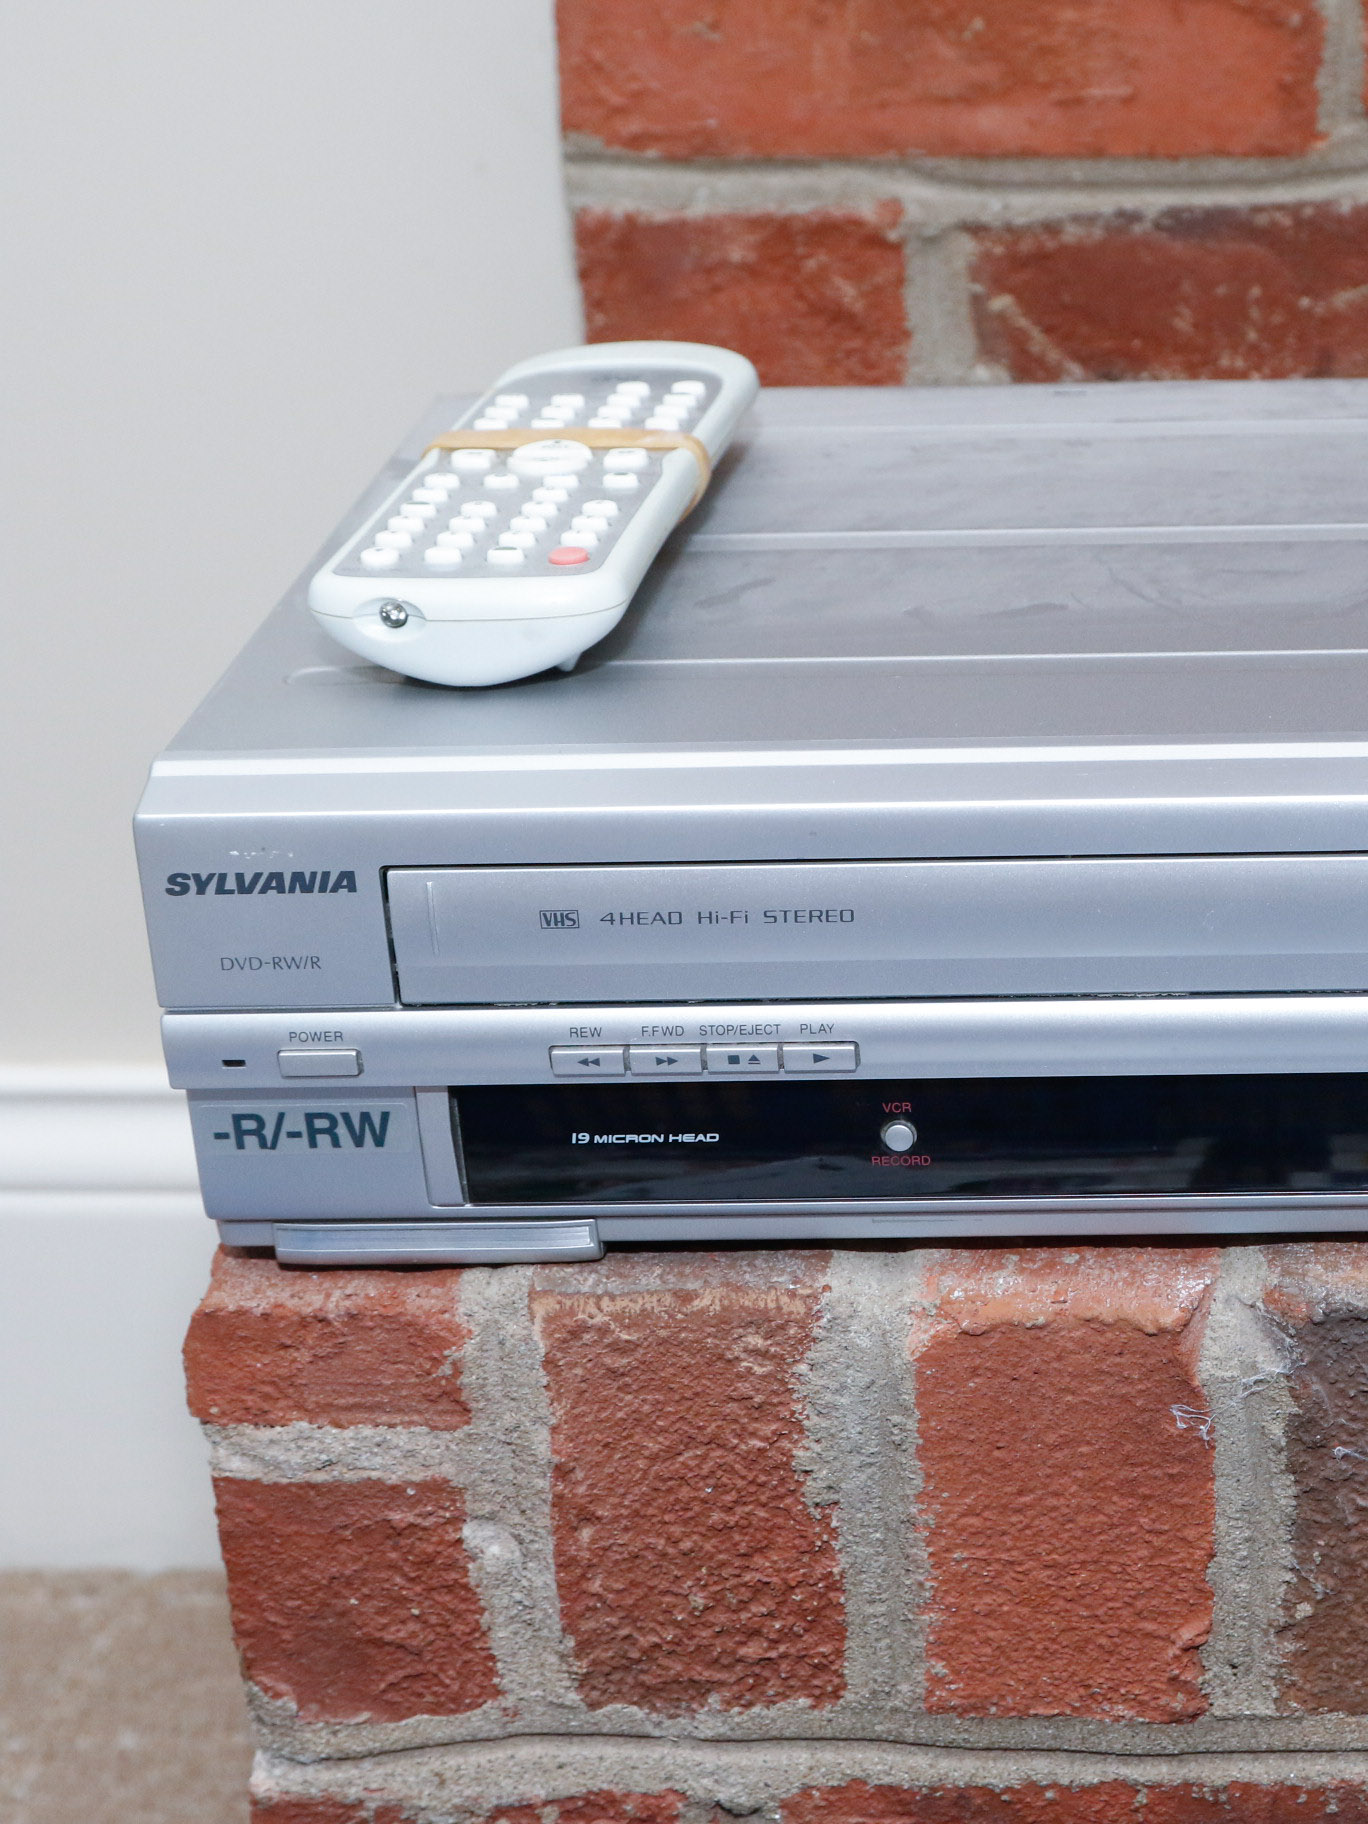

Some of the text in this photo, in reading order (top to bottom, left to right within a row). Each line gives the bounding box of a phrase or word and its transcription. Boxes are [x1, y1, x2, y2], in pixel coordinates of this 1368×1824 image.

[165, 870, 358, 897] SYLVANIA
[541, 911, 578, 928] VHS
[697, 909, 749, 925] Hi-Fi
[763, 908, 856, 924] STEREO
[220, 955, 322, 972] DVD-RW/R
[569, 1026, 603, 1039] REW
[699, 1023, 781, 1037] STOP/EJECT
[799, 1023, 835, 1035] PLAY
[288, 1031, 344, 1043] POWER
[882, 1101, 912, 1113] VCR
[213, 1111, 391, 1150] -R/-RW
[571, 1132, 720, 1145] 19 MICRON HEAD
[871, 1155, 931, 1167] RECORD
